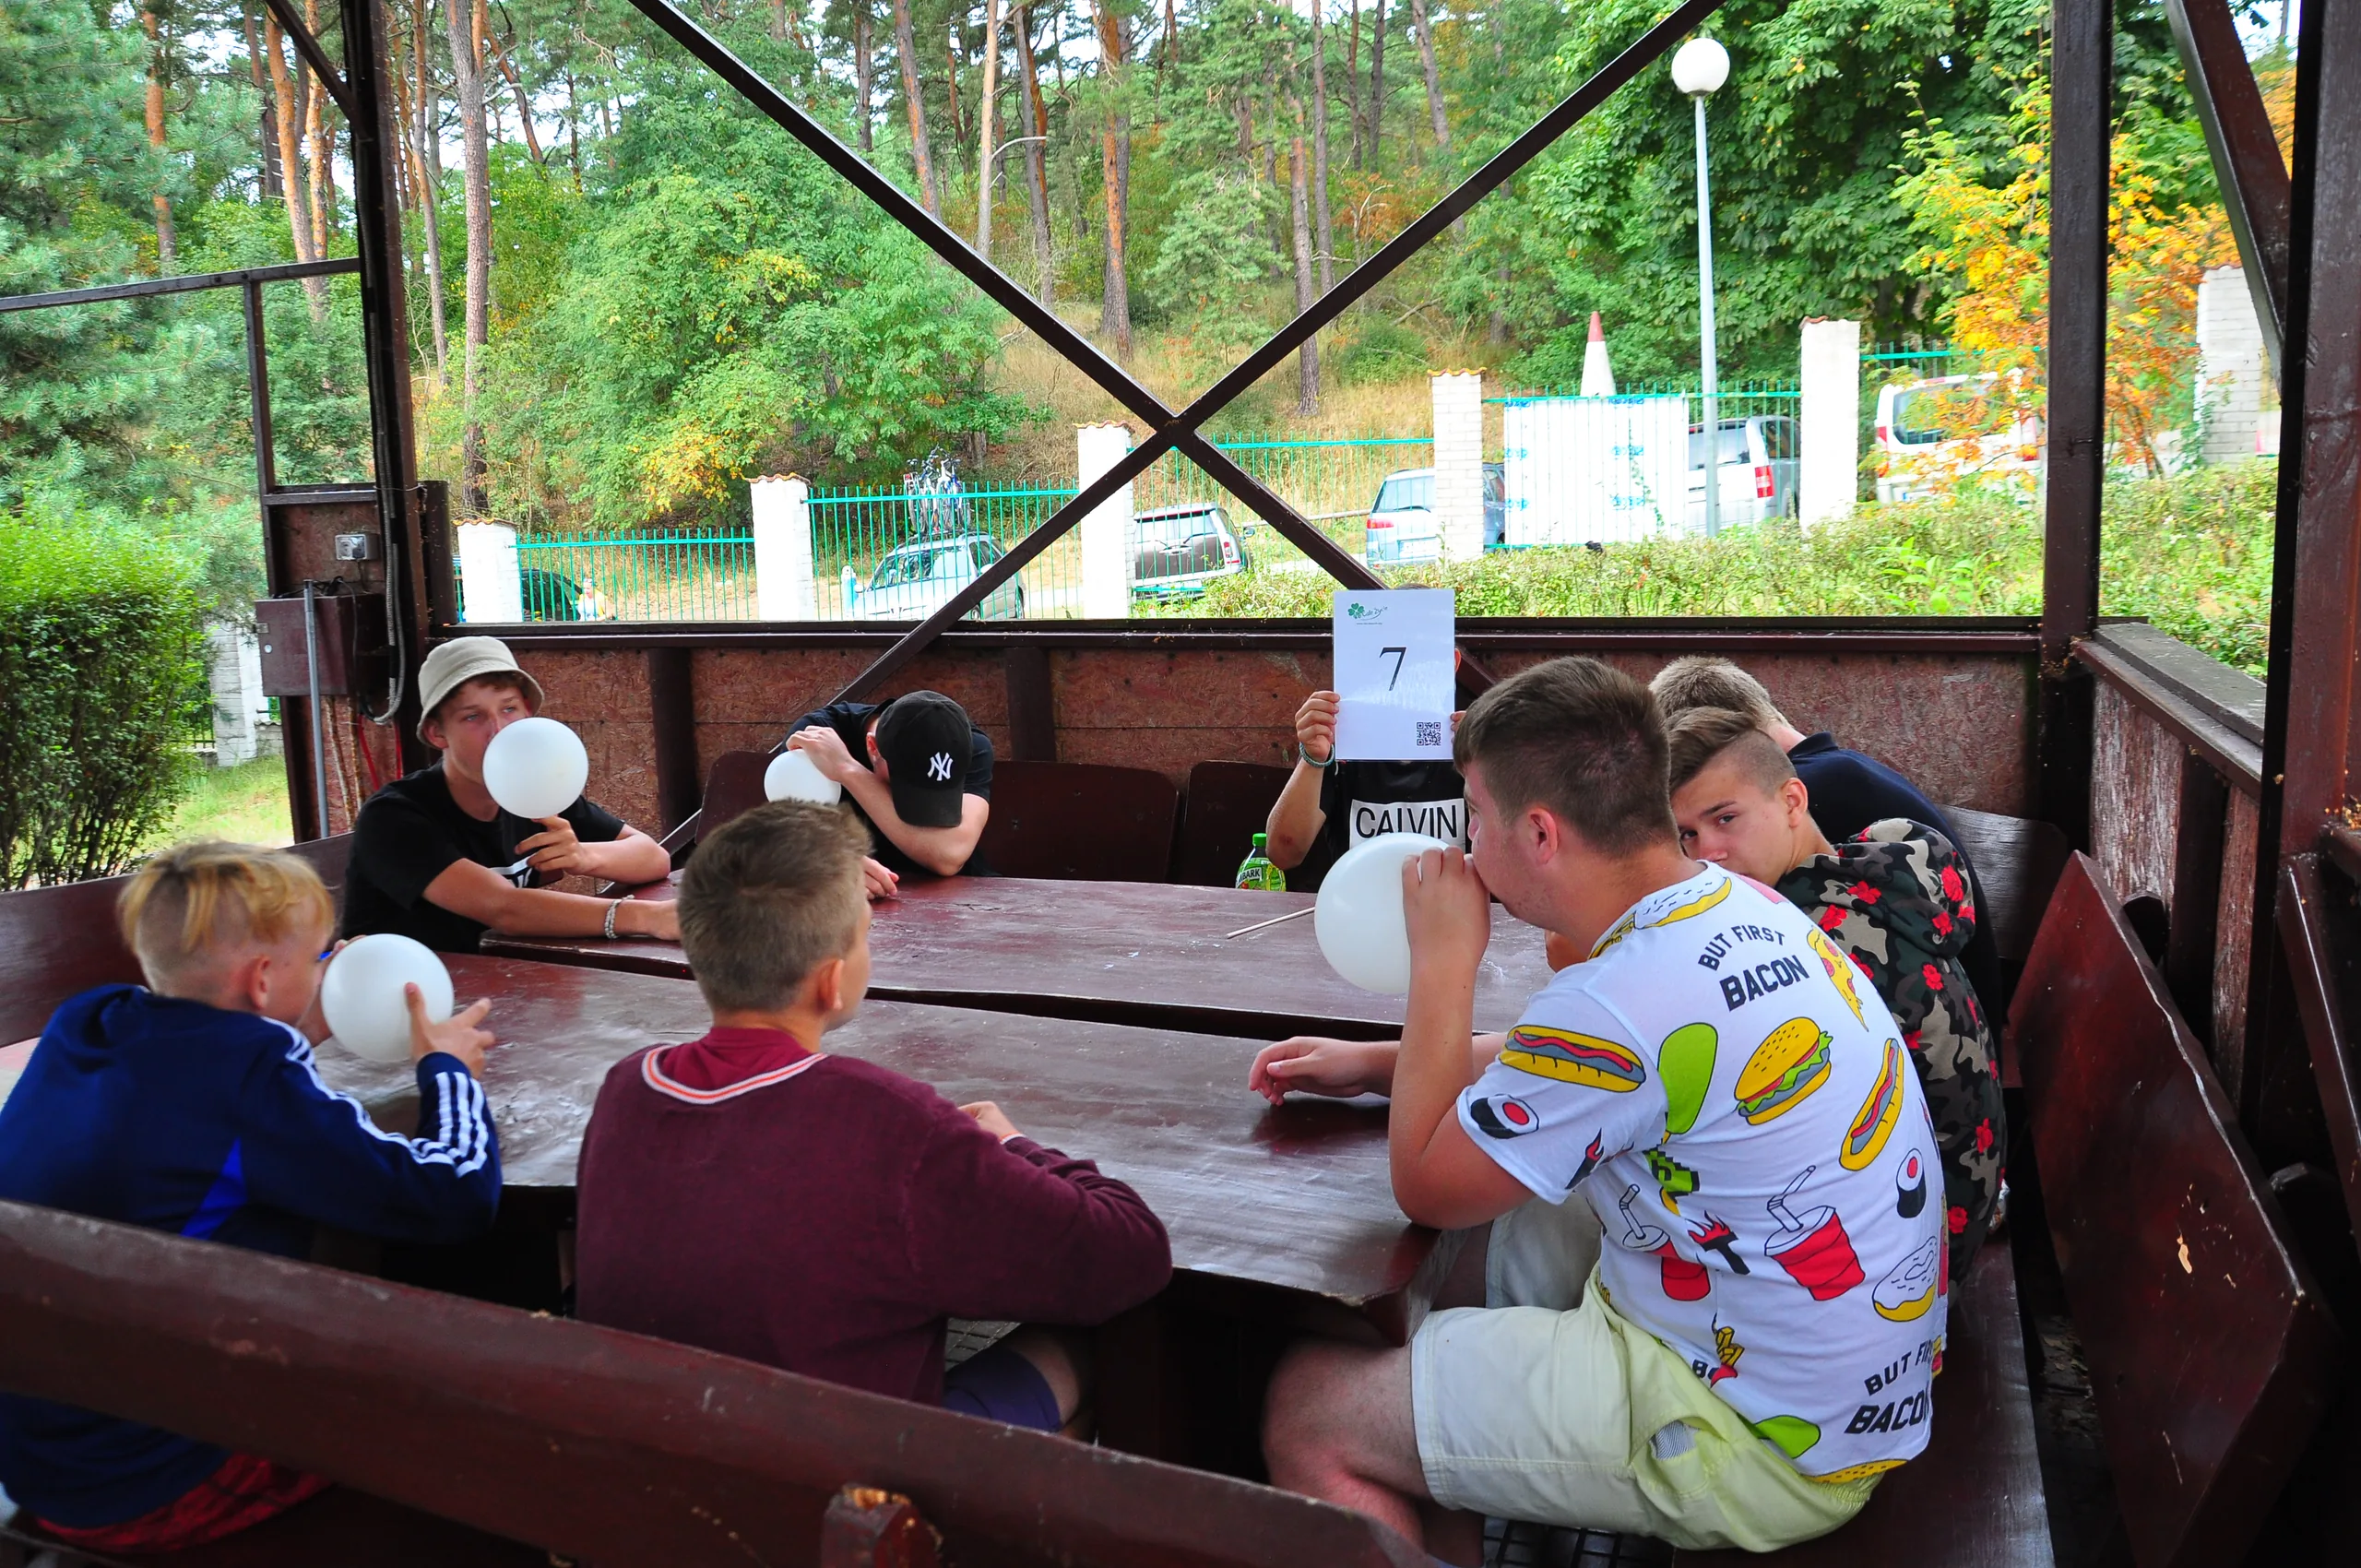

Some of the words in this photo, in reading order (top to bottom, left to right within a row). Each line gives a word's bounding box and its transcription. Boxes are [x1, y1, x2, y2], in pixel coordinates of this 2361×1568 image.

[1379, 647, 1406, 691] 7
[927, 752, 954, 781] NY
[1698, 932, 1732, 971] BUT
[1731, 924, 1785, 946] FIRST
[1719, 955, 1809, 1012] BACON
[1864, 1350, 1912, 1396] BUT
